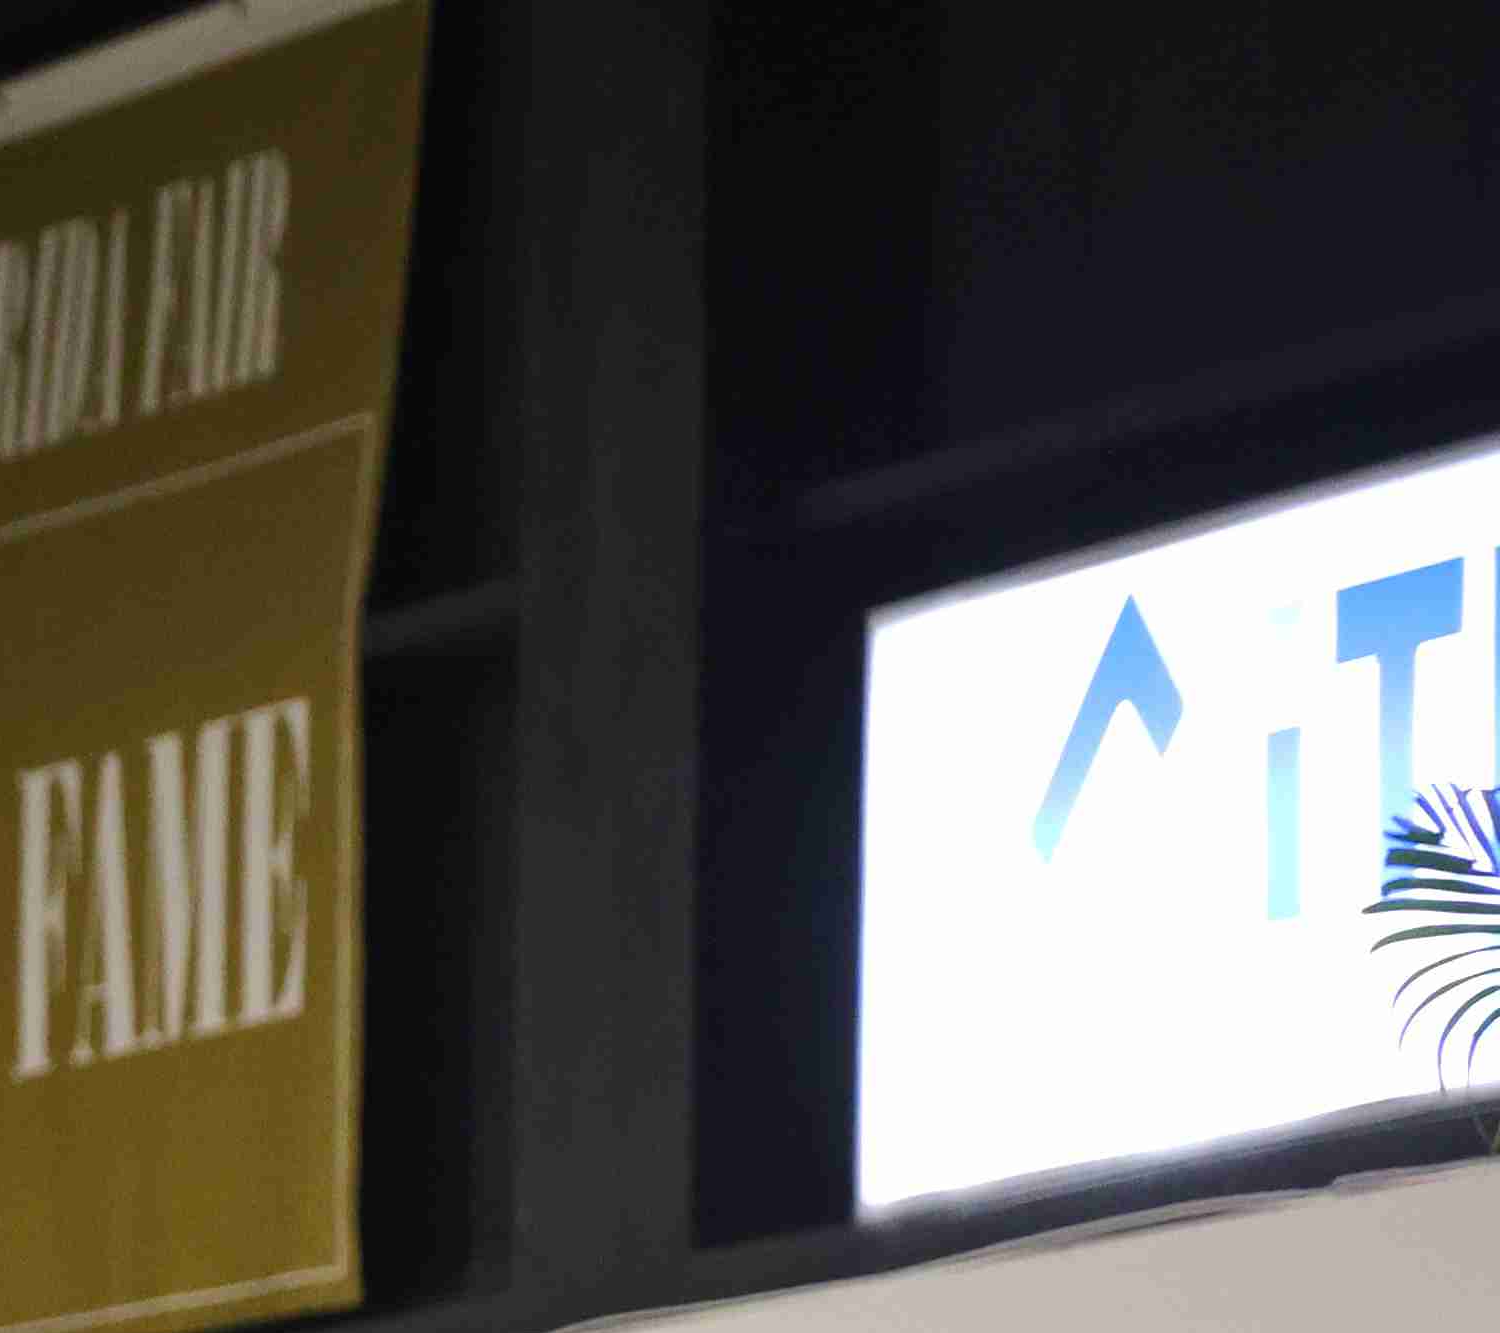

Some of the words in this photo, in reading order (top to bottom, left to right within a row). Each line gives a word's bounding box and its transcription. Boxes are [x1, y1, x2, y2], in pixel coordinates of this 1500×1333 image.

[140, 145, 292, 415] FAIR
[9, 696, 312, 1084] FAME
[1267, 540, 1500, 922] iT
